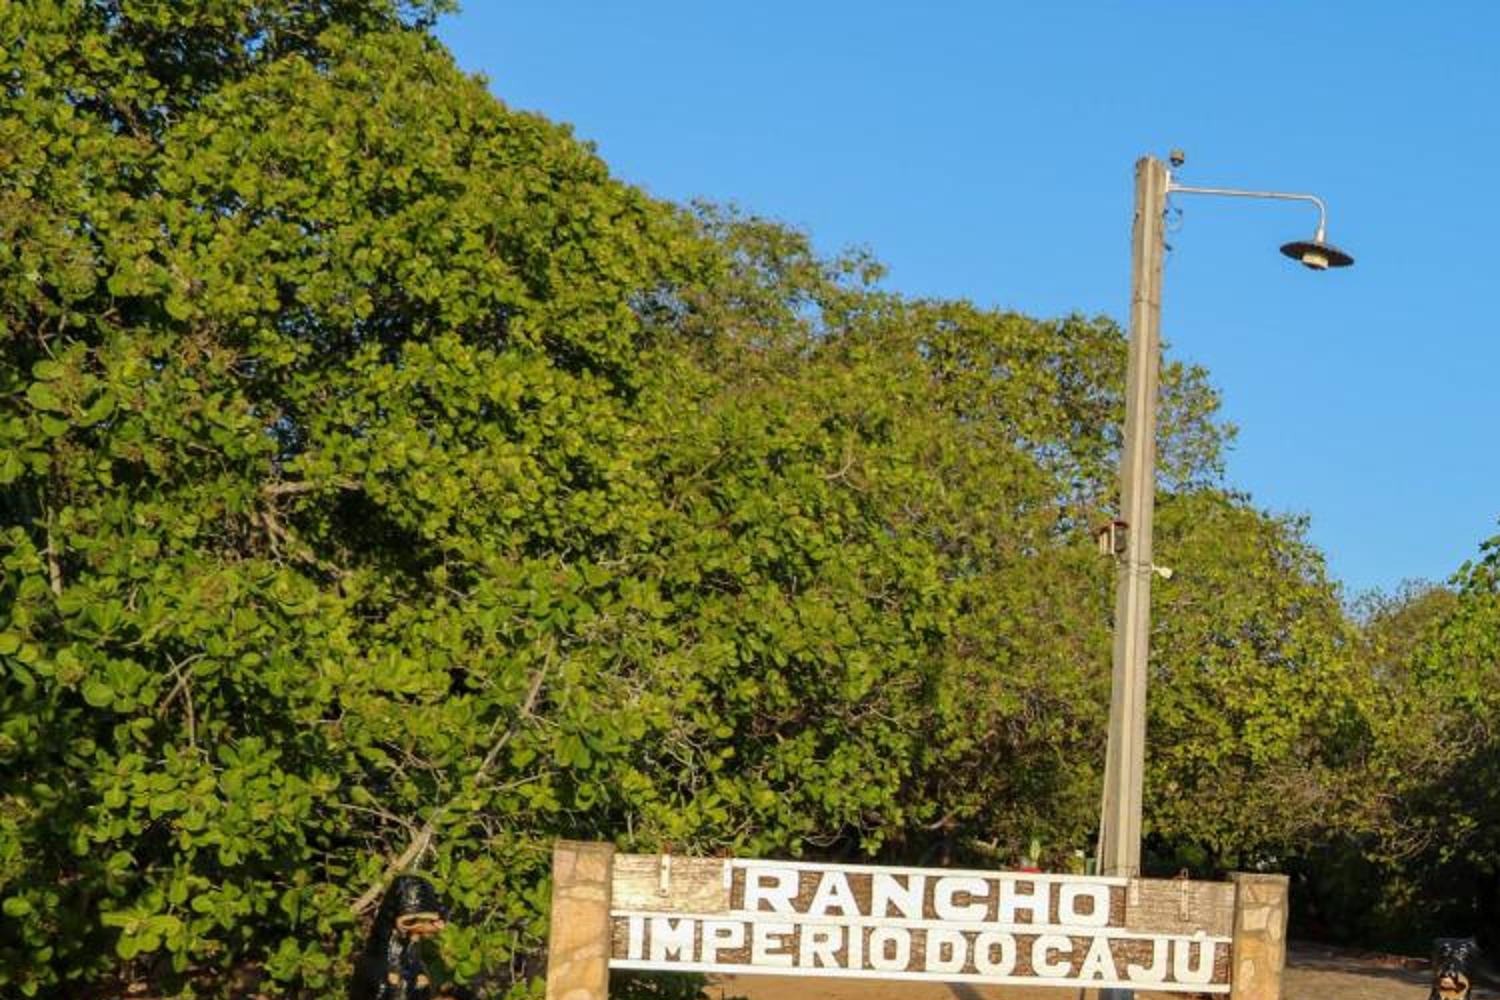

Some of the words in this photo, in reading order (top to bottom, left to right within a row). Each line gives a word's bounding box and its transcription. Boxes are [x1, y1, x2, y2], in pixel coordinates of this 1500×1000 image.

[744, 866, 1111, 927] RANCHO
[627, 915, 911, 972] IMPERIO
[925, 928, 1017, 977] DO
[1031, 930, 1216, 984] CAJÚ
